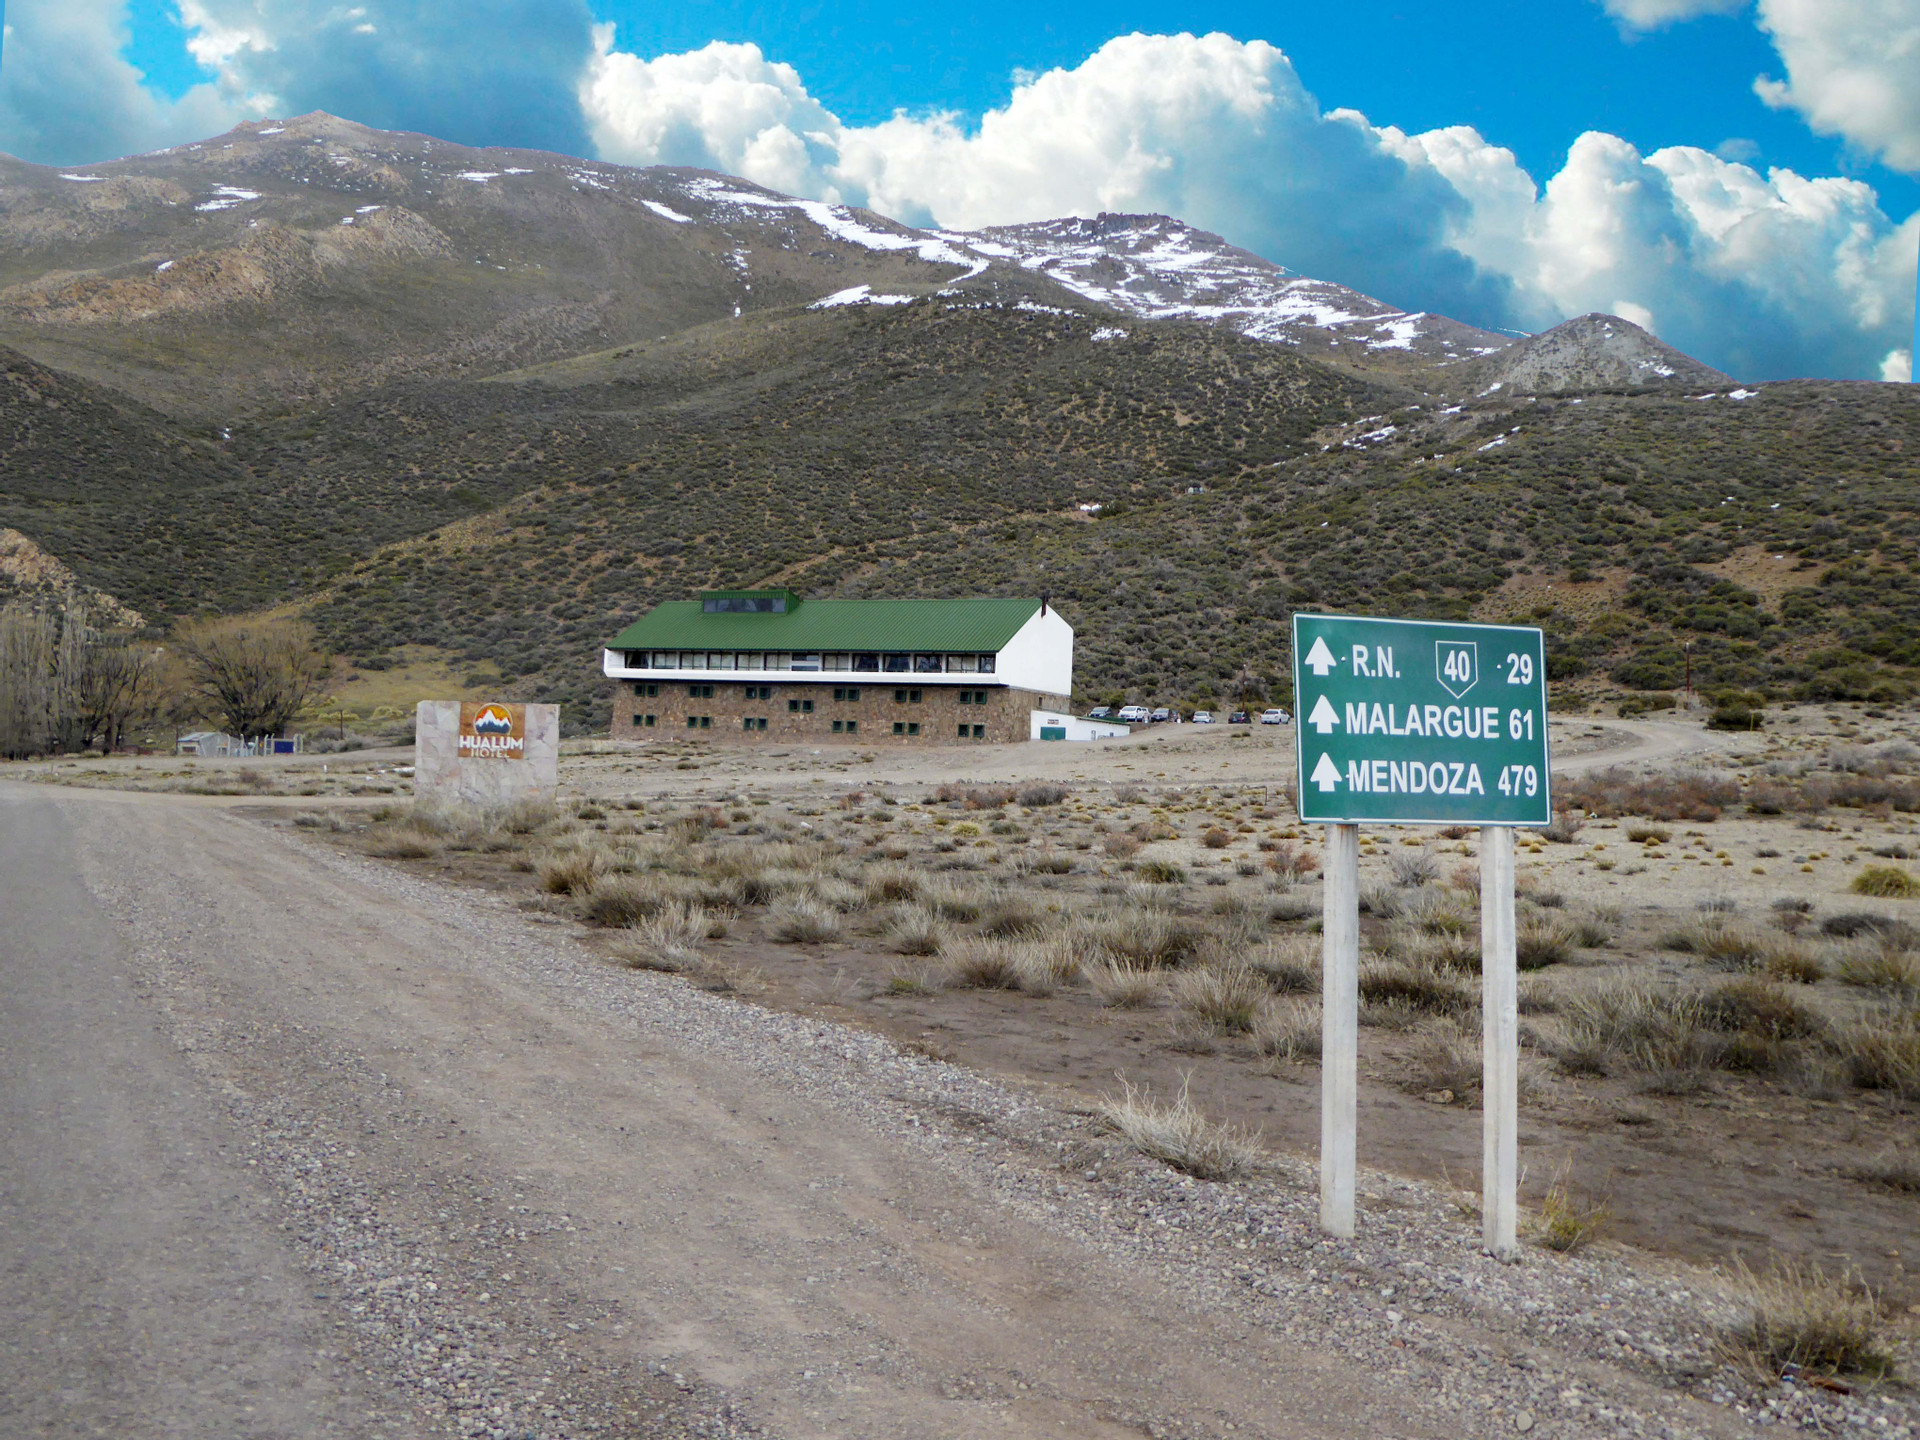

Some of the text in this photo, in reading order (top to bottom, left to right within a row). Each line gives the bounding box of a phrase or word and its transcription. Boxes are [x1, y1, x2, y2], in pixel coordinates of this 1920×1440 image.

[1352, 645, 1533, 685] R.N. 40 29
[1345, 702, 1533, 740] MALARGUE 61
[459, 735, 523, 750] HUALUM
[470, 748, 510, 758] HOTEL
[1348, 760, 1538, 796] MENDOZA 479
